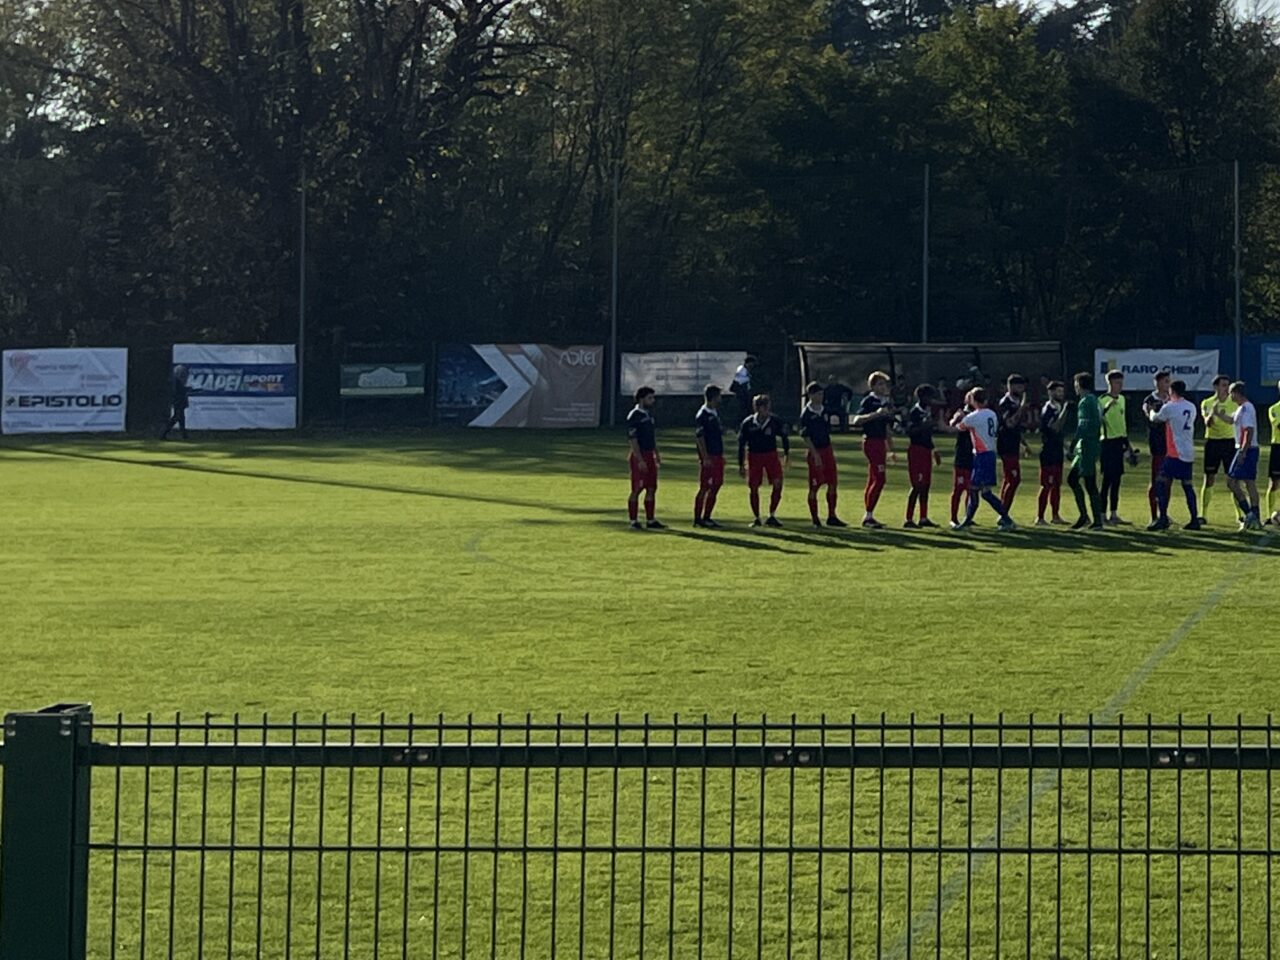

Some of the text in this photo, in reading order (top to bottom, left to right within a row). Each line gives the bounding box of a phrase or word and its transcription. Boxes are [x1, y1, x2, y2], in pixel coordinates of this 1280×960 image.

[1122, 365, 1158, 374] RARO
[1162, 366, 1199, 374] CHEM
[186, 373, 242, 391] MAPEI
[243, 374, 284, 383] SPORT
[19, 395, 122, 407] EPISTOLIO
[987, 417, 996, 437] 8
[1182, 410, 1191, 430] 2
